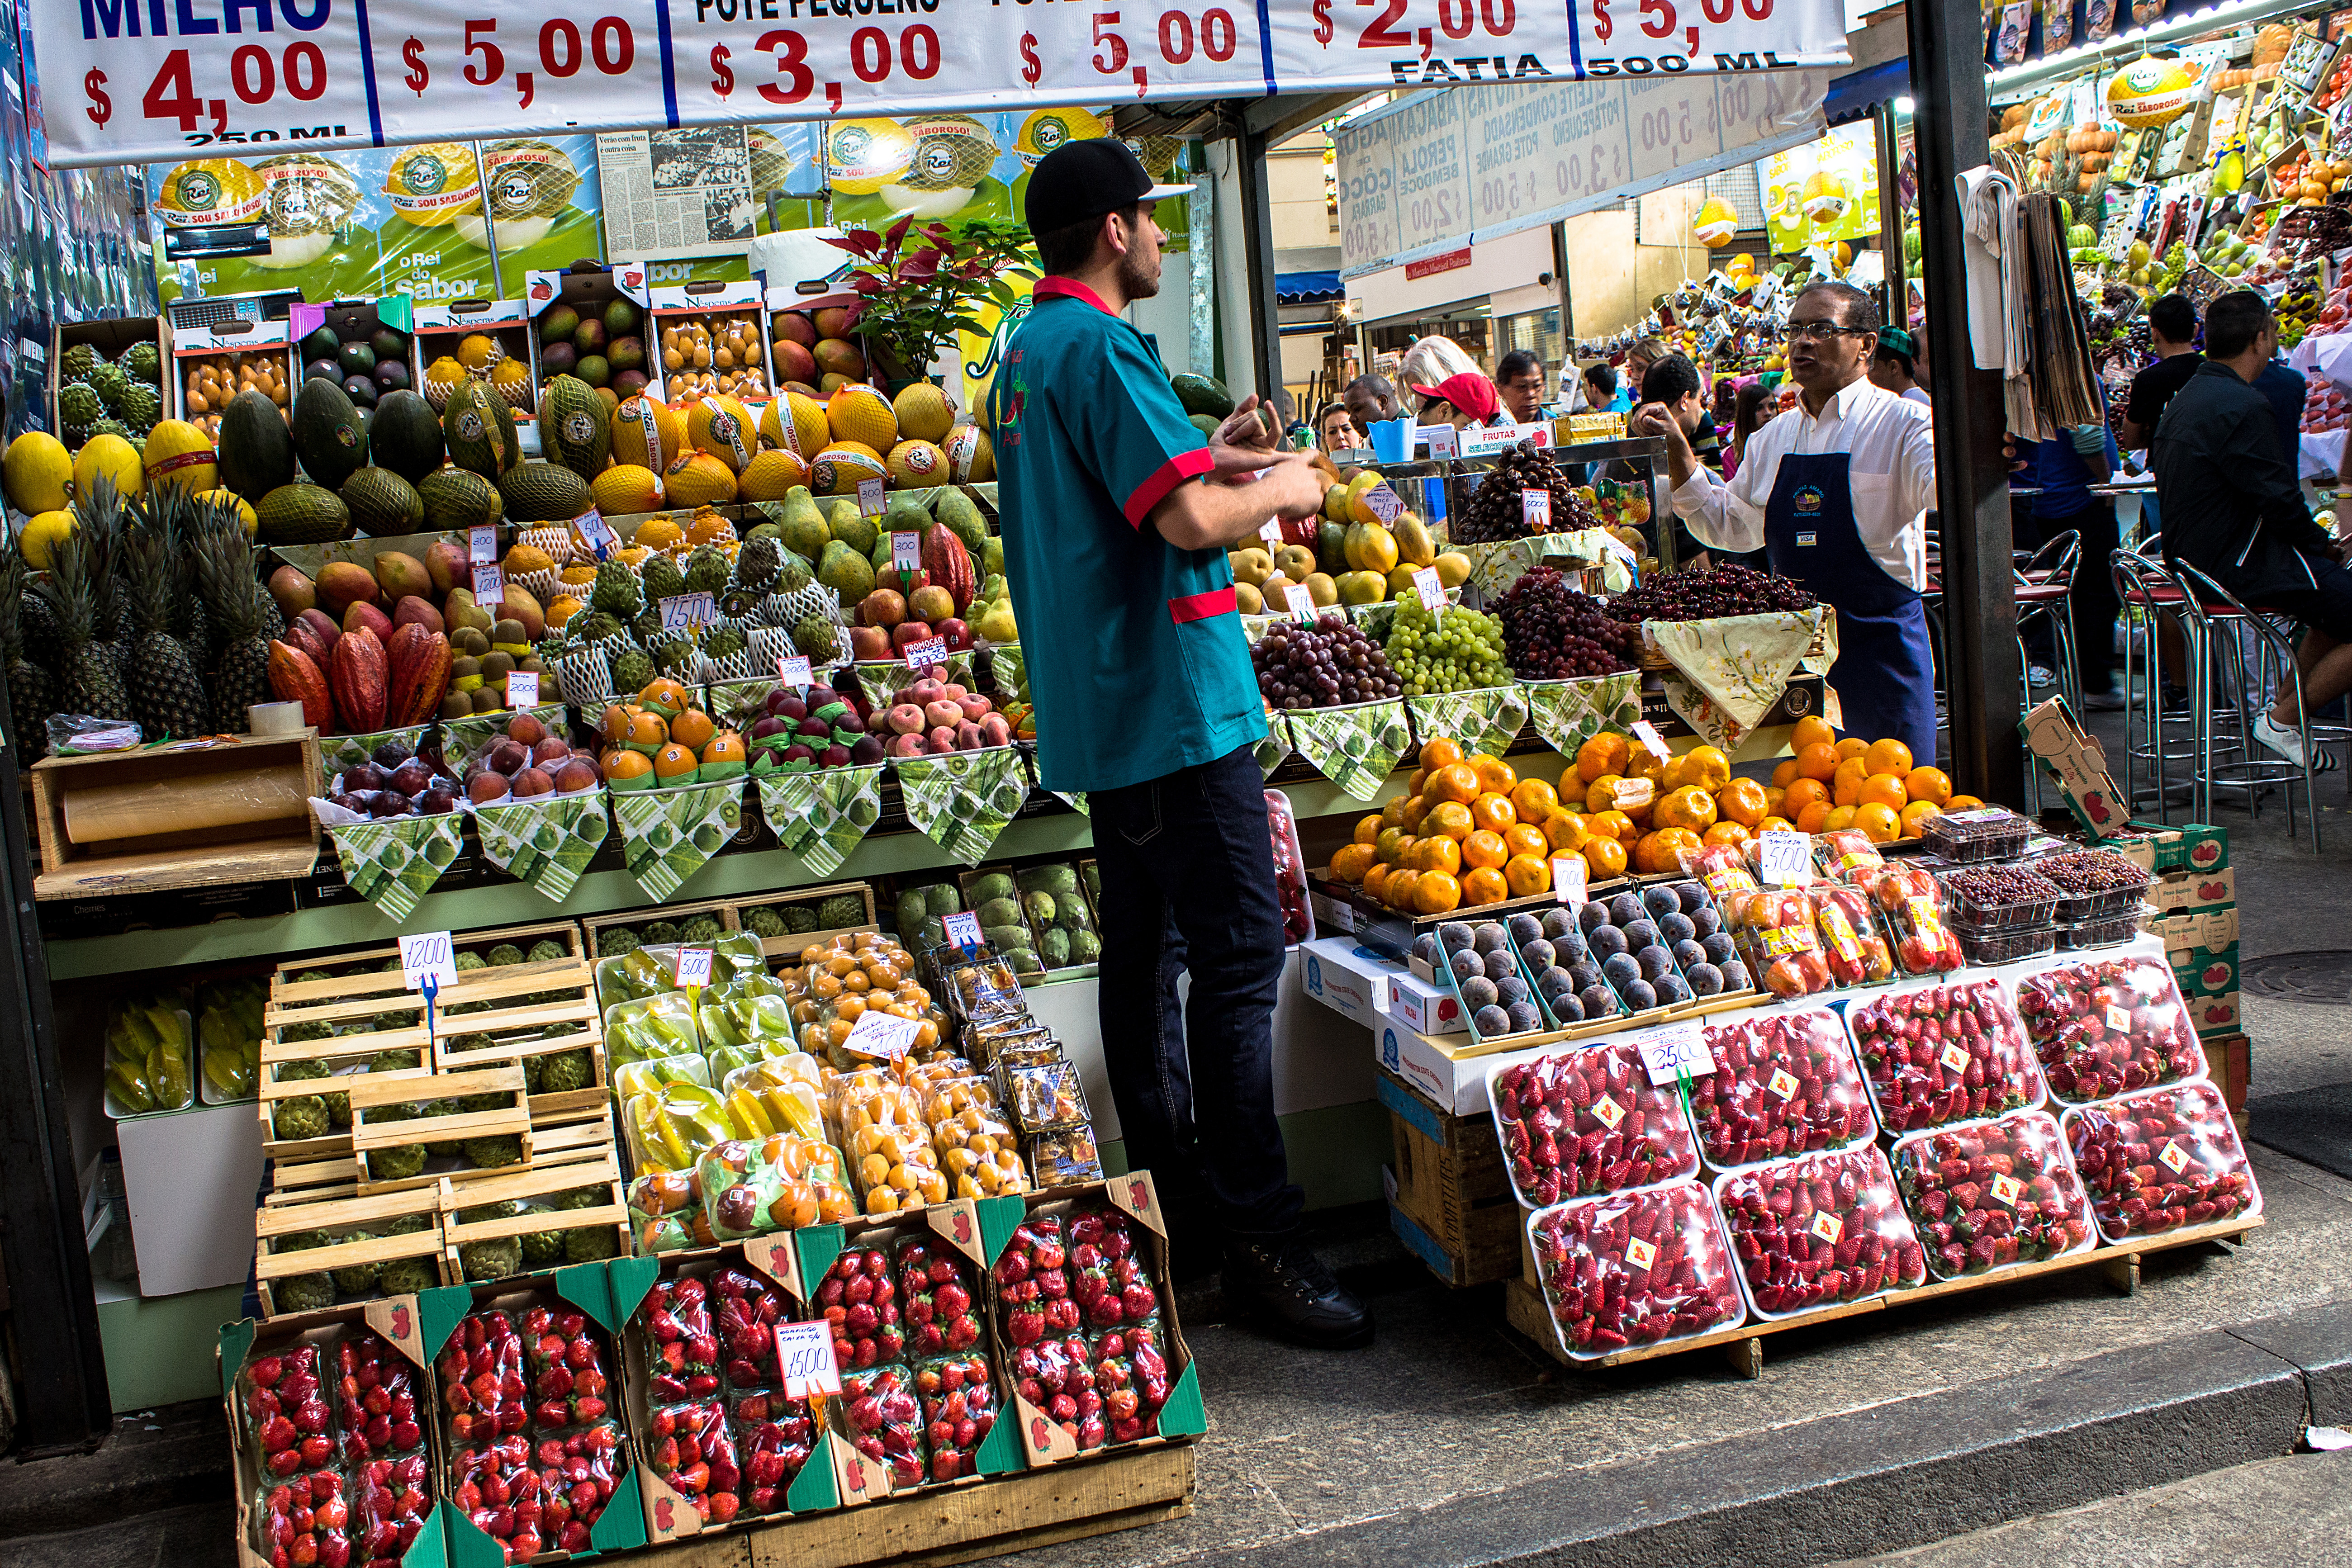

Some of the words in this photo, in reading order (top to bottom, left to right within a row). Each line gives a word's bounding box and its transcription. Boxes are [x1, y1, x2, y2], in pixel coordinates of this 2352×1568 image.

[1593, 0, 1612, 45] $
[1313, 0, 1333, 50] $
[1357, 0, 1516, 62] 2,00
[1020, 30, 1042, 89] $
[1092, 8, 1236, 99] 5,00
[402, 35, 430, 98] $
[463, 16, 635, 110] 5,00
[711, 42, 735, 102] $
[754, 24, 941, 115] 3,00
[1390, 53, 1552, 84] FATIA
[1589, 55, 1689, 76] 500
[1713, 52, 1798, 71] ML
[2129, 66, 2158, 81] Rei
[85, 66, 112, 130] $
[142, 41, 327, 137] 4,00
[2114, 104, 2135, 114] Rei
[2138, 97, 2183, 114] SABOROSO!
[913, 126, 970, 137] SABOROSO!
[1038, 129, 1061, 145] Rei
[1820, 134, 1835, 149] SOU
[488, 154, 549, 166] SABOROSO!
[924, 154, 953, 169] Rei
[411, 168, 437, 185] Rei
[182, 184, 213, 202] Rei
[500, 184, 532, 199] Rei
[417, 199, 437, 208] SOU
[192, 213, 212, 223] SOU
[399, 256, 410, 268] o
[412, 251, 441, 266] Rei
[412, 268, 430, 280] do
[1412, 267, 1429, 279] Mercado
[1429, 261, 1449, 275] Municipal
[395, 277, 479, 301] Sabor
[686, 296, 731, 310] Nêsperas
[446, 314, 495, 329] Nêsperas
[210, 337, 259, 351] Nêsperas
[1482, 429, 1516, 441] FRUTAS
[1792, 485, 1807, 499] FRUTAS
[1809, 485, 1825, 499] AMARO
[2065, 753, 2077, 767] Peso
[2075, 765, 2089, 786] líquido
[2175, 887, 2192, 896] líquido
[74, 903, 105, 915] Cherries
[2168, 928, 2181, 936] Peso
[2181, 926, 2198, 936] líquido
[1638, 1025, 1689, 1043] MORANGO
[779, 1325, 817, 1336] MORANGO
[786, 1347, 829, 1379] 15,00
